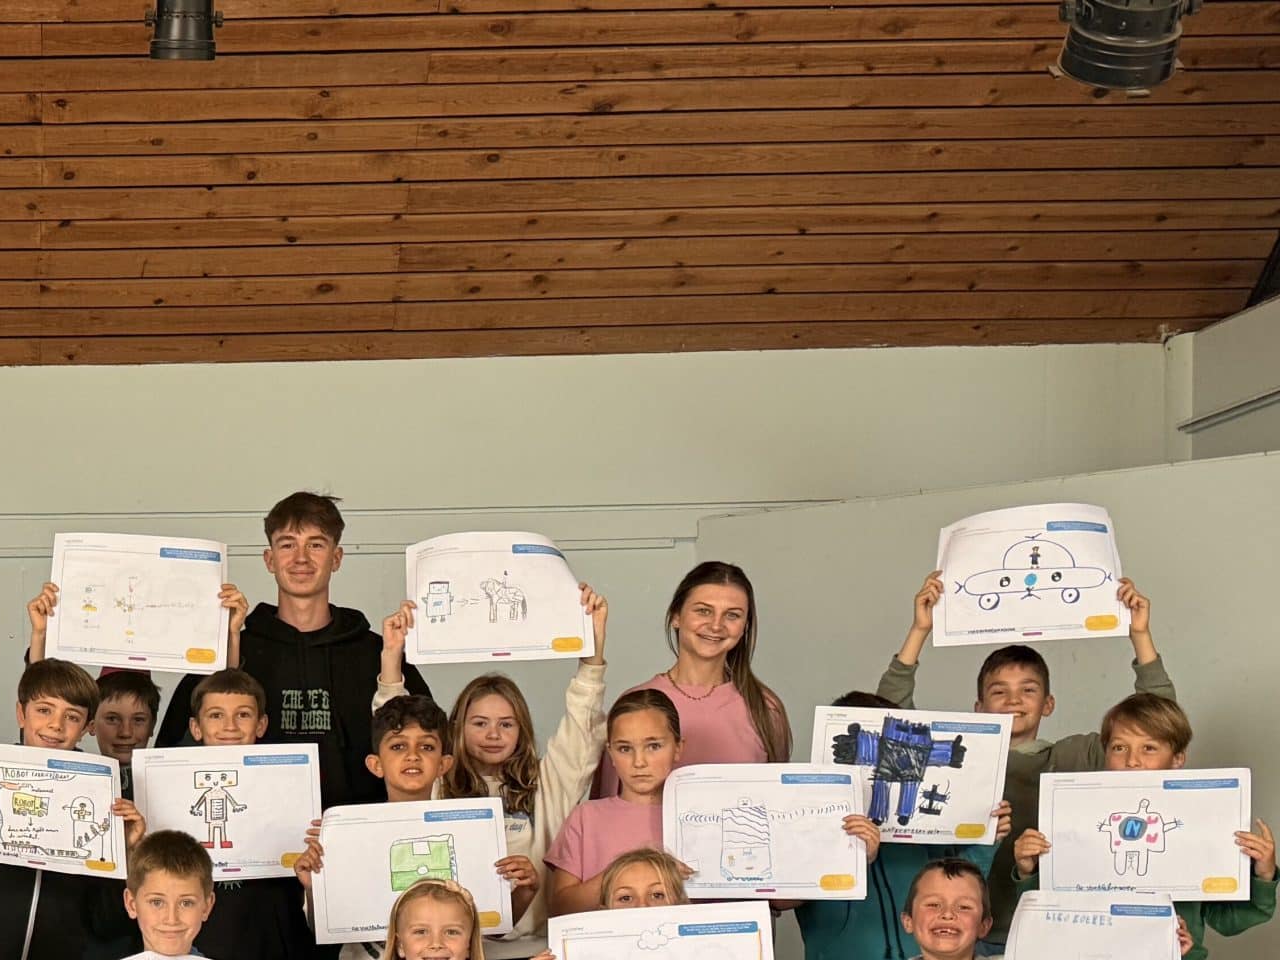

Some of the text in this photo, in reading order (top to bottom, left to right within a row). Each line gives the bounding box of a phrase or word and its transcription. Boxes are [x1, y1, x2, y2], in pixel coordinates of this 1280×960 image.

[281, 688, 330, 709] THEE'S
[280, 710, 331, 730] NO RUSH
[1125, 820, 1141, 837] N
